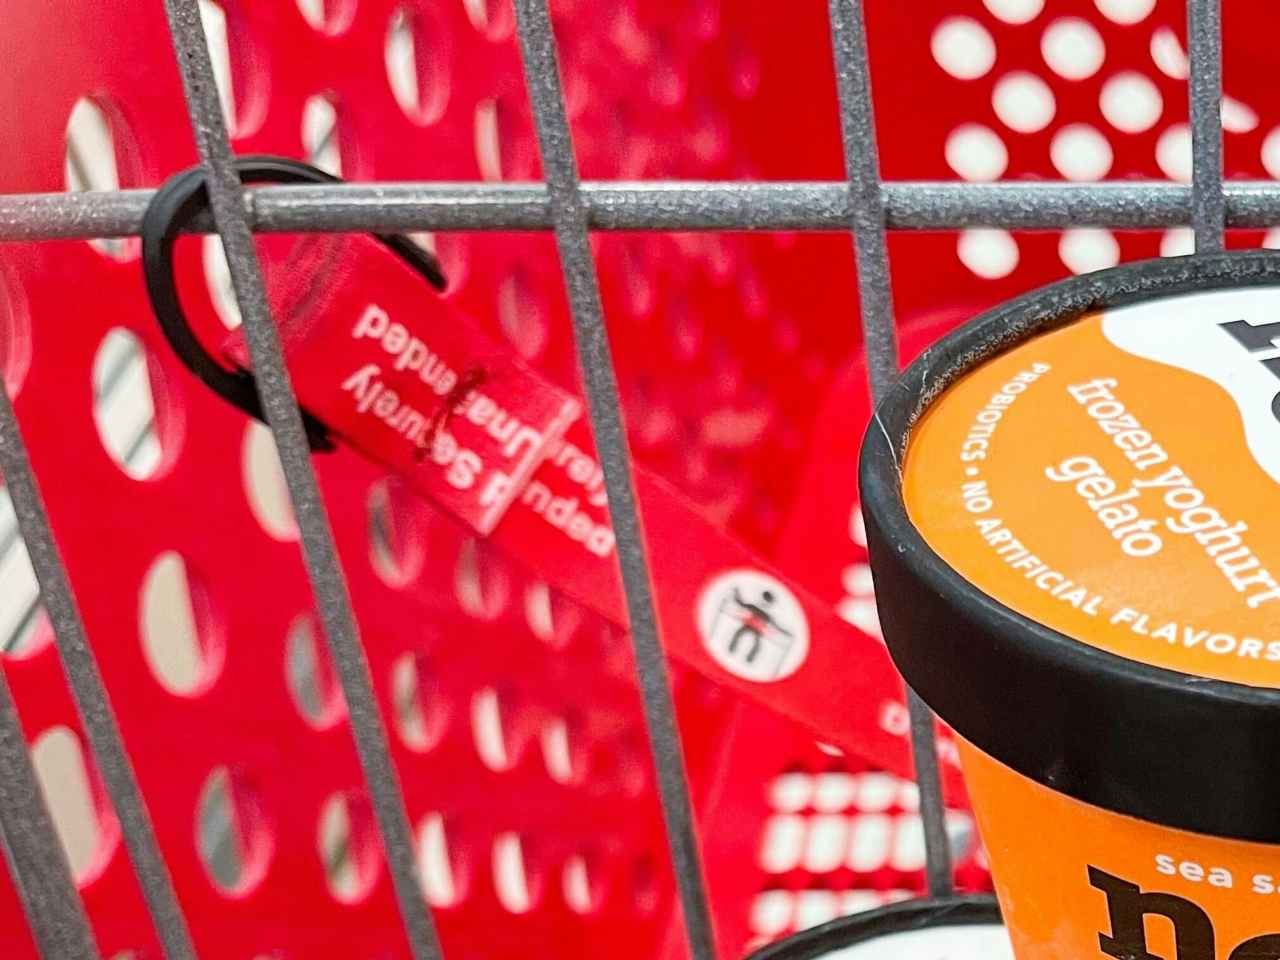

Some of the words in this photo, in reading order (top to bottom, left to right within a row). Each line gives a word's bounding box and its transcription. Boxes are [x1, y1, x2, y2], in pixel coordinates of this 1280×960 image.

[341, 363, 483, 489] Seurely
[961, 361, 1052, 462] PROBIOTICS
[1066, 377, 1168, 489] frozen
[962, 480, 993, 513] NO
[1045, 453, 1163, 560] gelato
[974, 516, 1104, 616] ARTIFICIAL
[1154, 849, 1235, 889] sea
